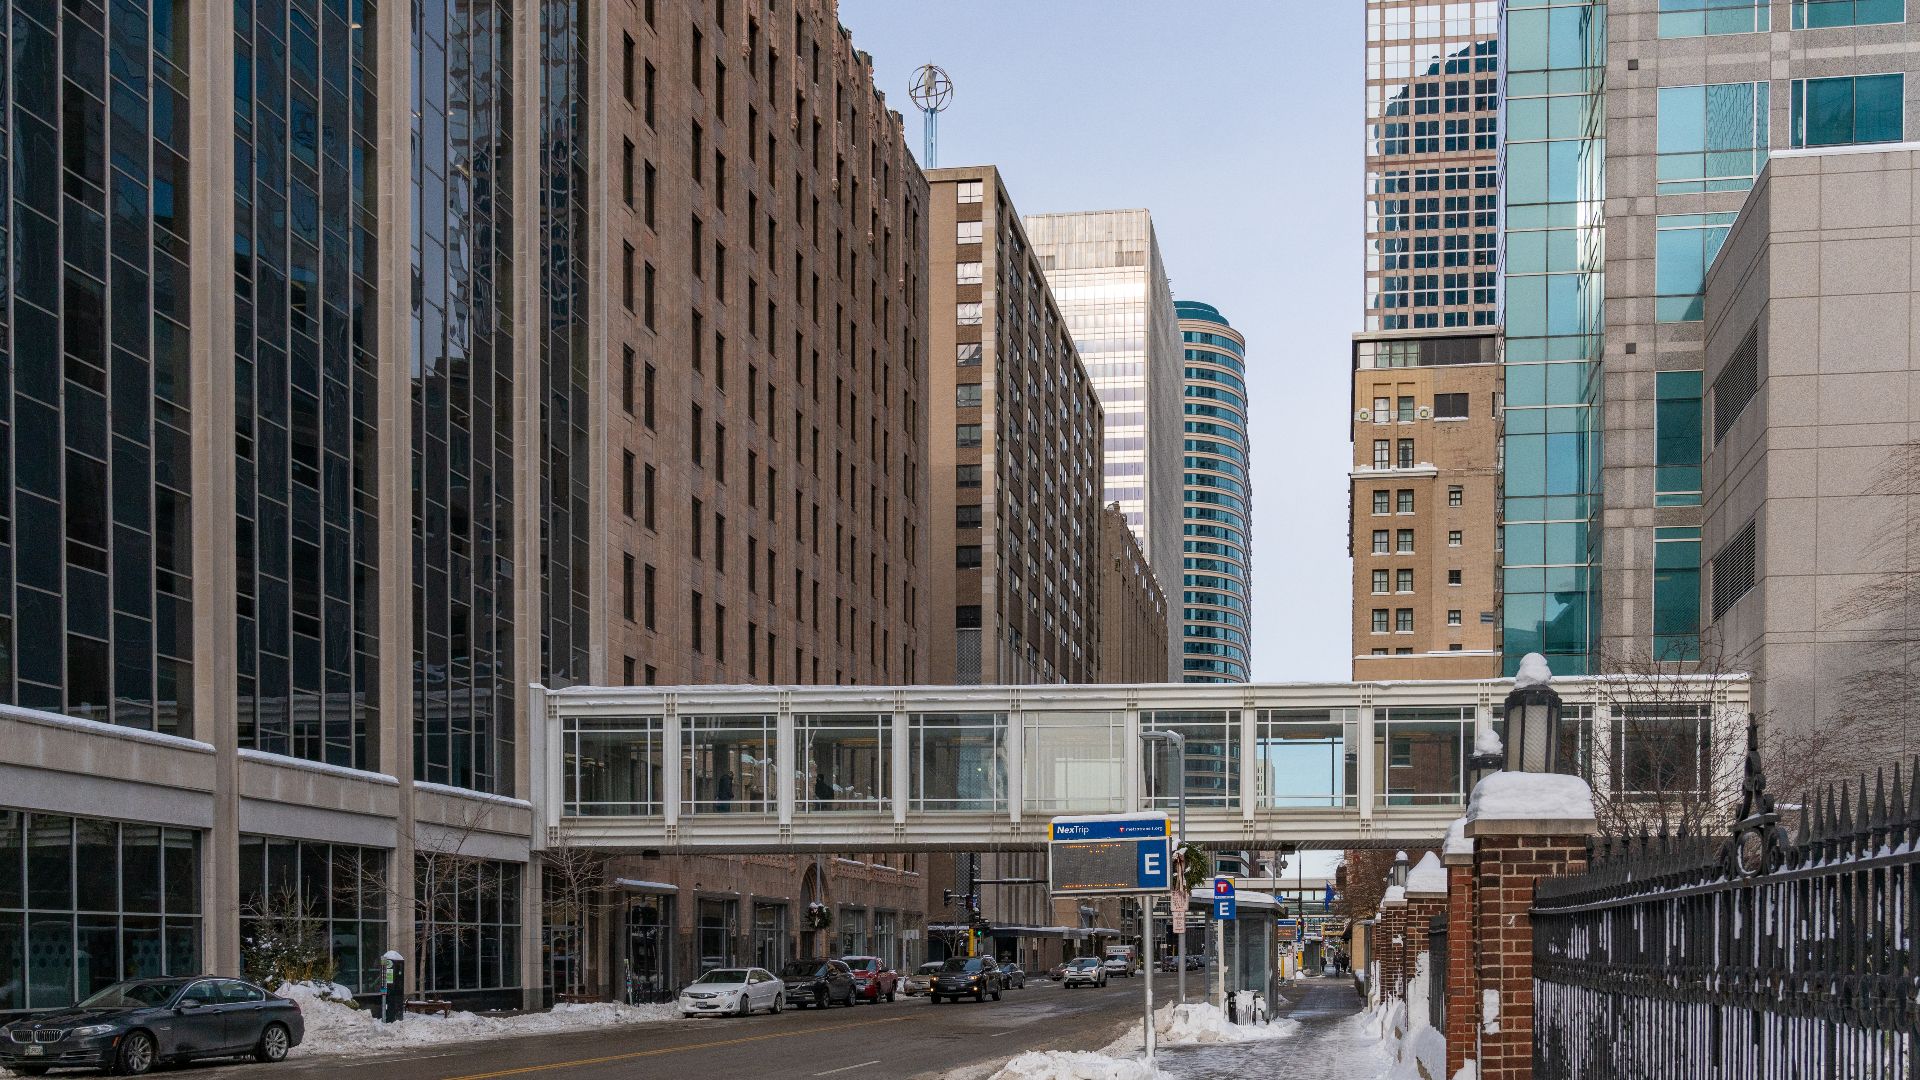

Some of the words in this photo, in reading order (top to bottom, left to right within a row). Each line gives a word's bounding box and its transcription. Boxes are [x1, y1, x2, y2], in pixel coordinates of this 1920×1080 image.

[1056, 825, 1089, 835] NexTrip
[1144, 853, 1160, 875] E
[1217, 883, 1227, 893] T
[1219, 902, 1230, 916] E
